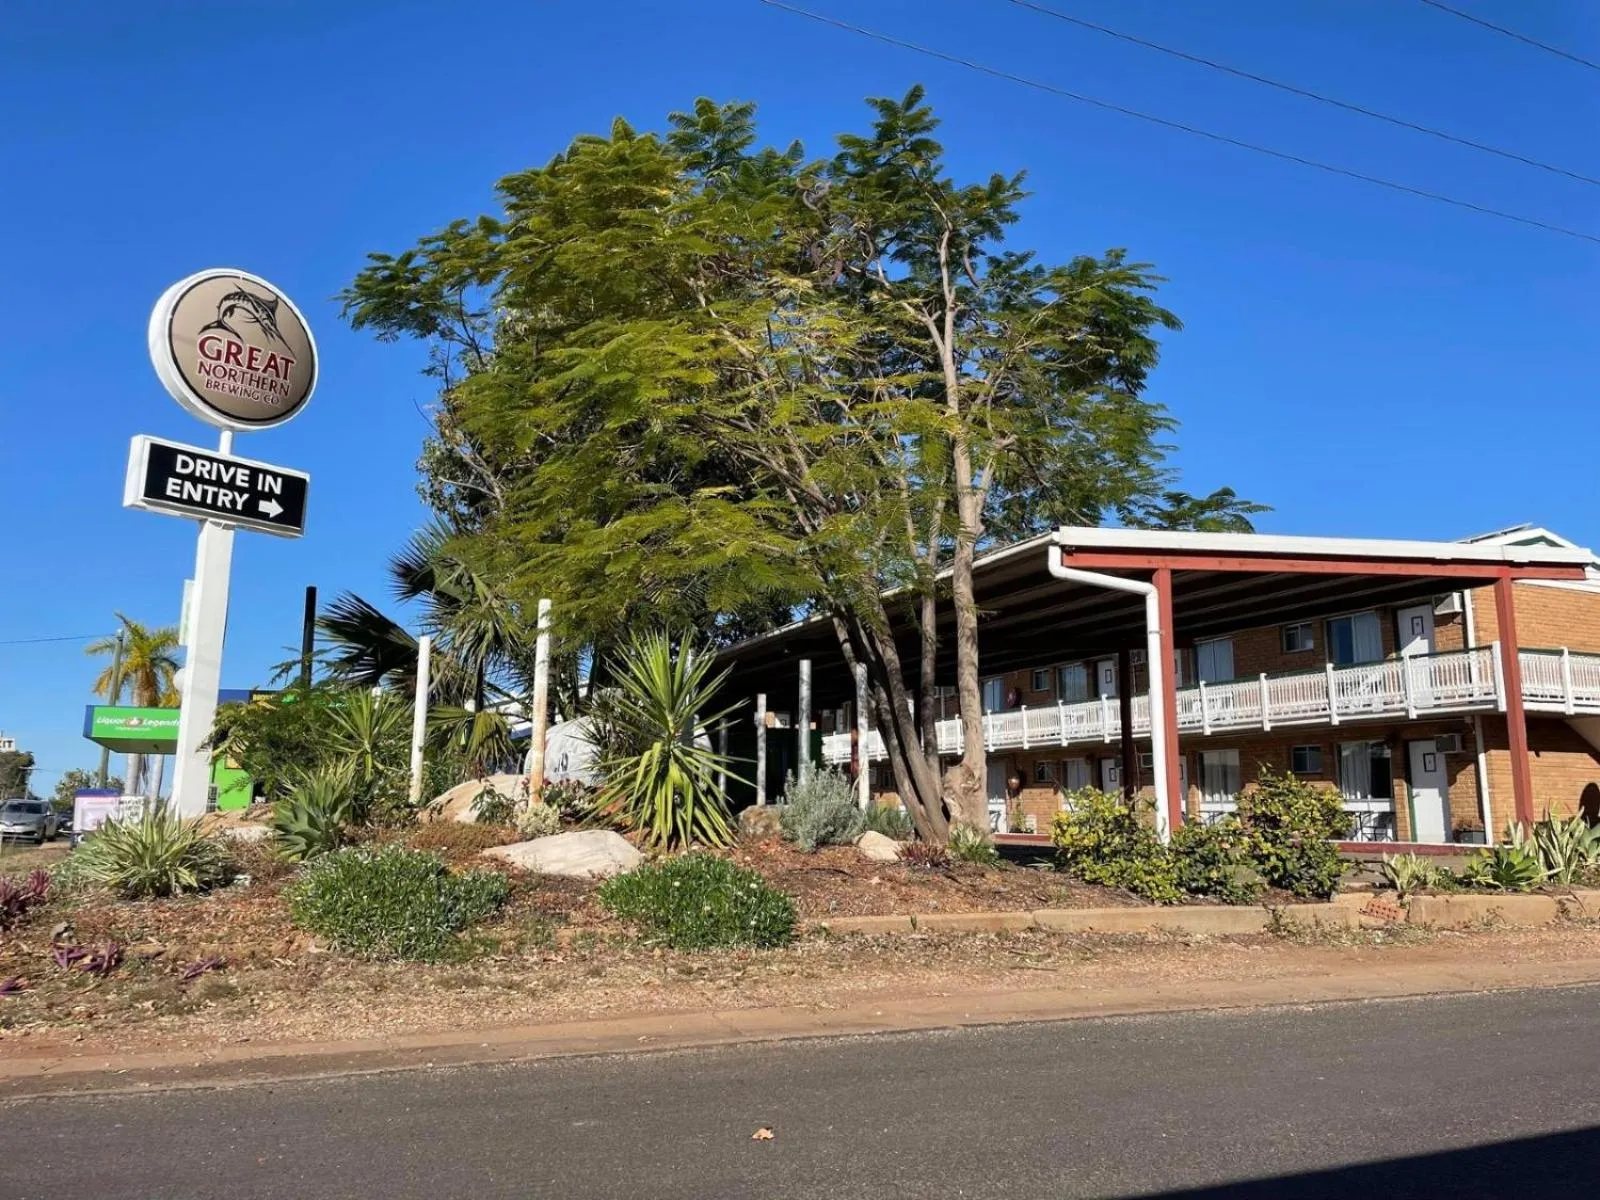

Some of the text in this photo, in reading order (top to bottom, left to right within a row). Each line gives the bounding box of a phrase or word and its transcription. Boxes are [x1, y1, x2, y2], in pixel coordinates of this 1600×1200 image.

[198, 335, 295, 381] GREAT
[198, 361, 290, 396] NORTHERN
[206, 378, 260, 401] BREWING
[175, 453, 283, 495] DRIVE IN
[165, 477, 250, 511] ENTRY
